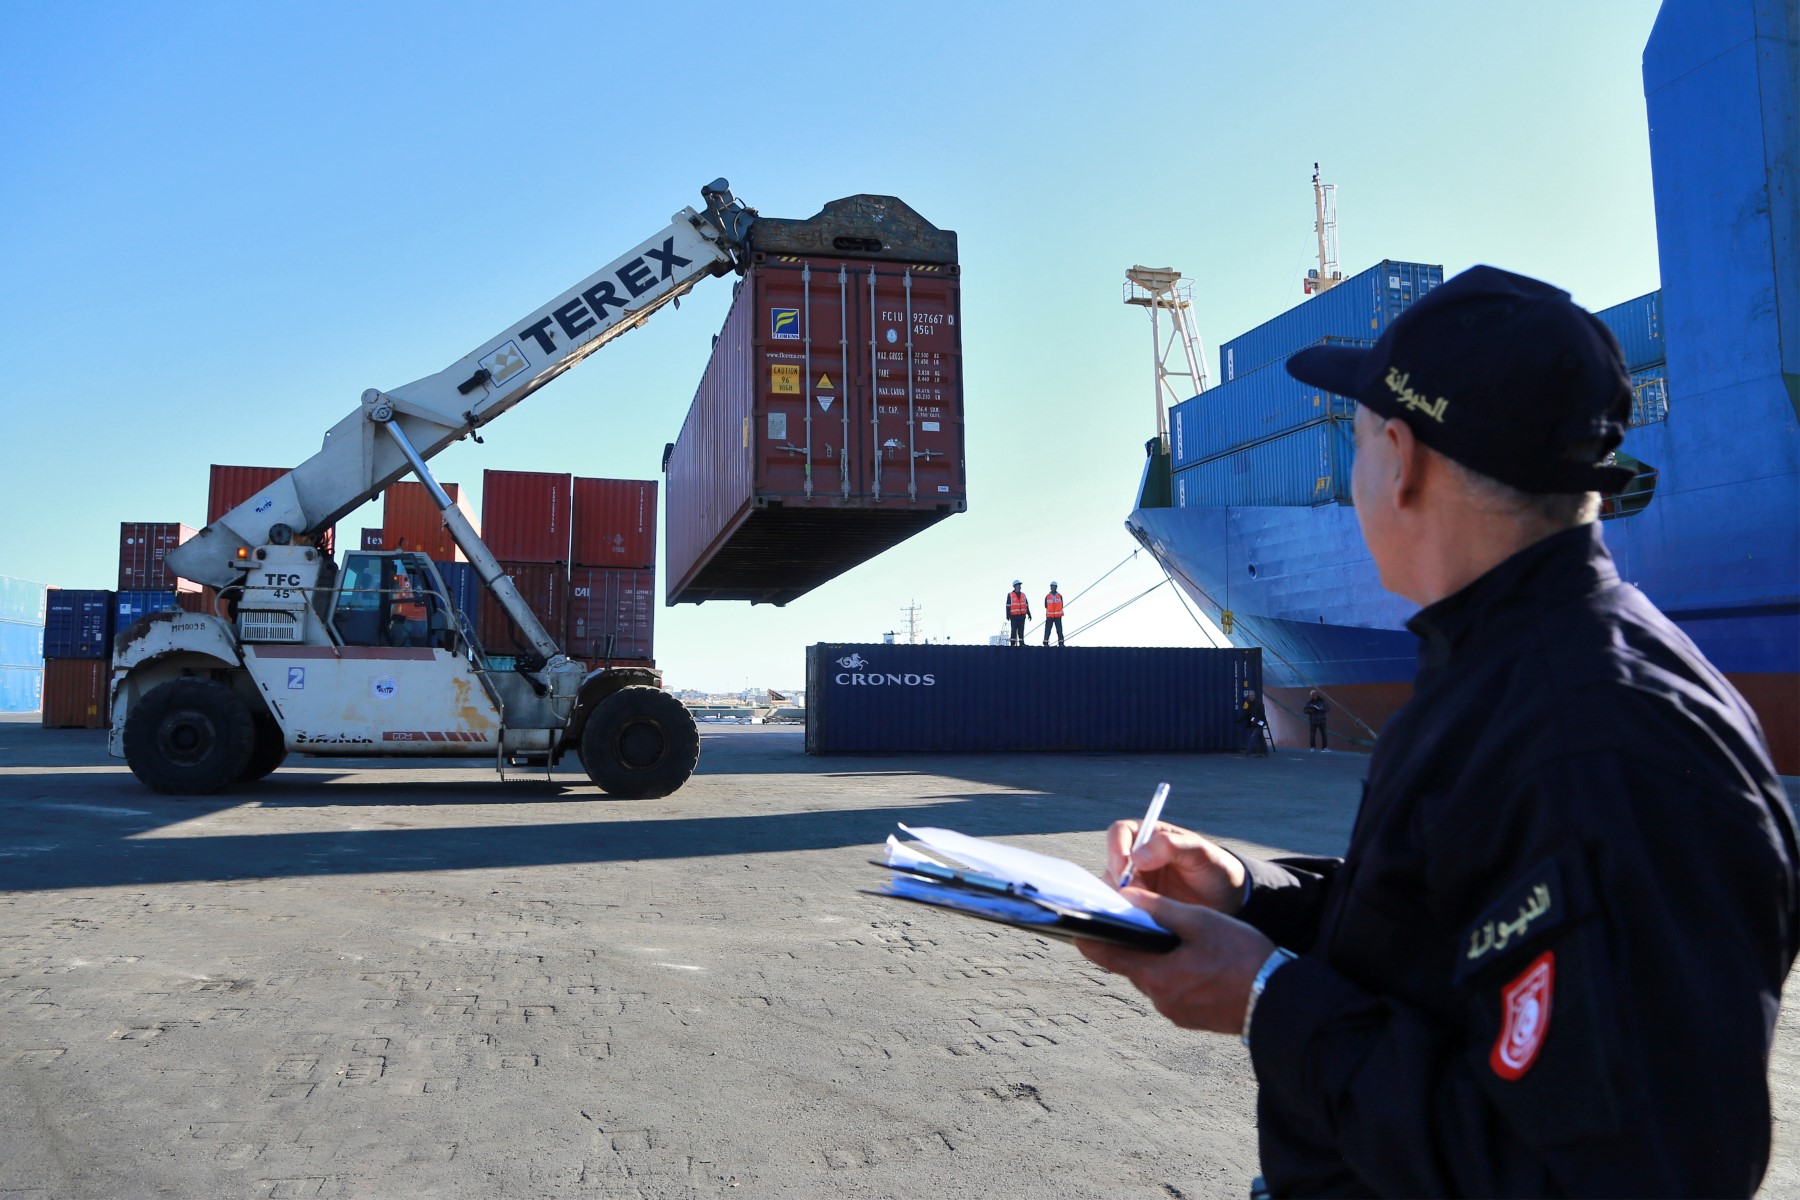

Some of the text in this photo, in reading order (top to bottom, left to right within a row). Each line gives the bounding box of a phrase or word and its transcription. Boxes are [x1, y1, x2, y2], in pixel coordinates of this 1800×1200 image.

[518, 236, 693, 355] TEREX
[882, 311, 903, 321] FCIU
[913, 313, 943, 324] 927667
[914, 325, 934, 335] 45G1
[773, 367, 798, 375] CAUTION
[878, 369, 889, 378] TARE
[1385, 367, 1449, 423] الديوانة
[265, 573, 301, 586] TFC
[273, 589, 290, 599] 45
[574, 587, 590, 597] CAI
[835, 673, 936, 686] CRONOS
